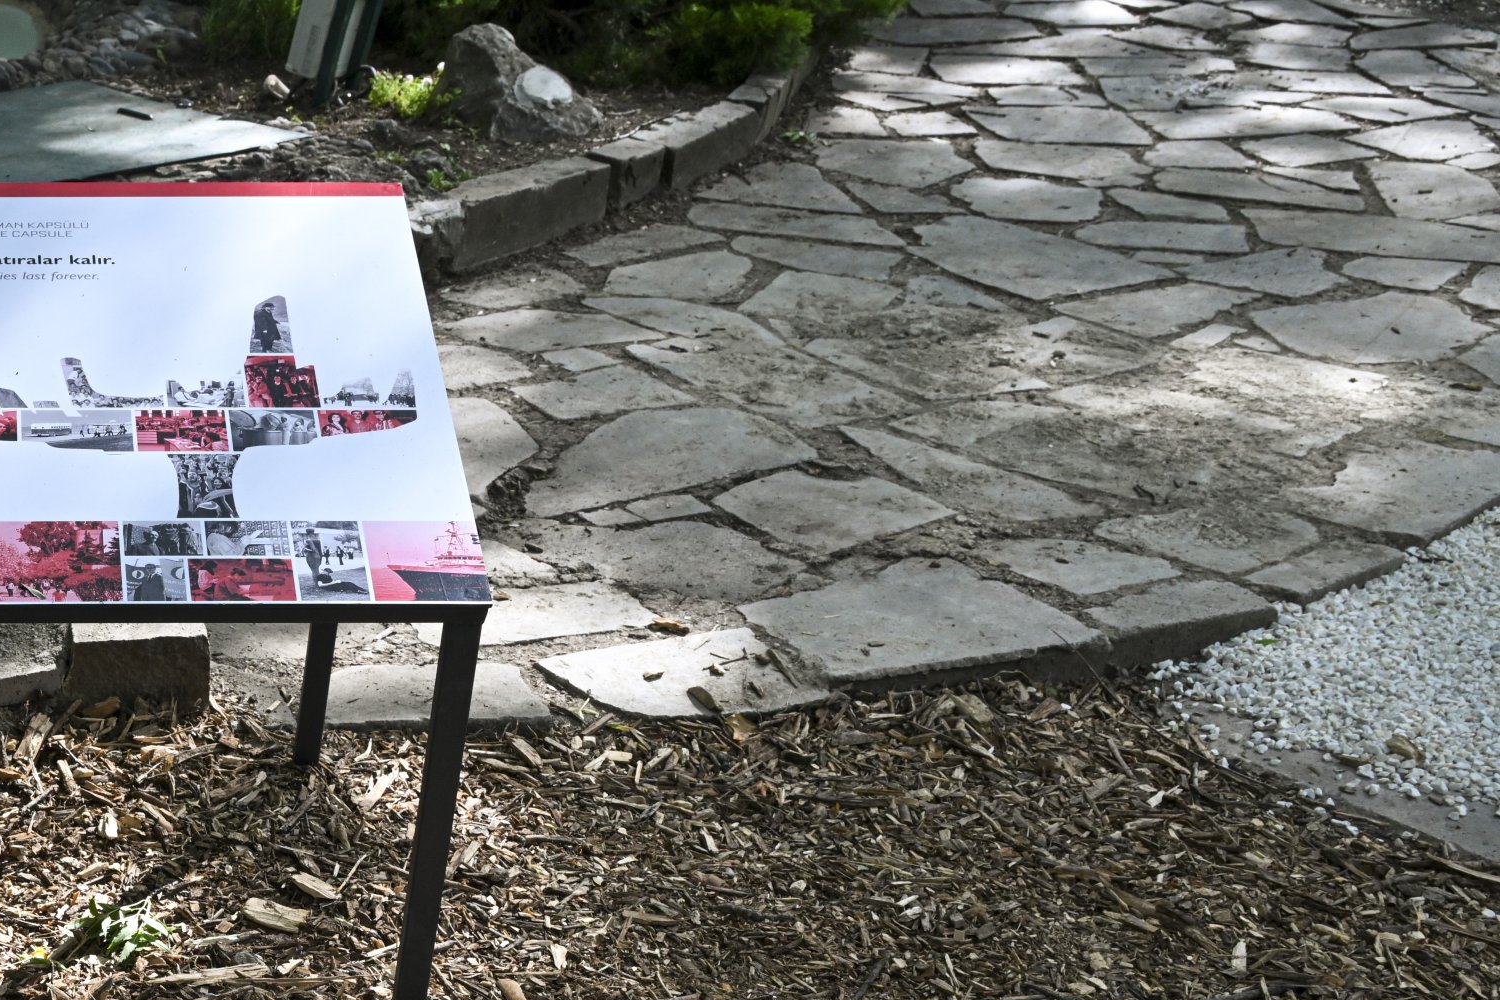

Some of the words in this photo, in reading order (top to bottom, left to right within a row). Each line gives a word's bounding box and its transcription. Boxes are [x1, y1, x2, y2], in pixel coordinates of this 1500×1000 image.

[28, 220, 89, 229] KAPSÜLÜ
[70, 255, 115, 265] kalır.
[23, 272, 46, 280] last
[52, 272, 99, 282] forever.
